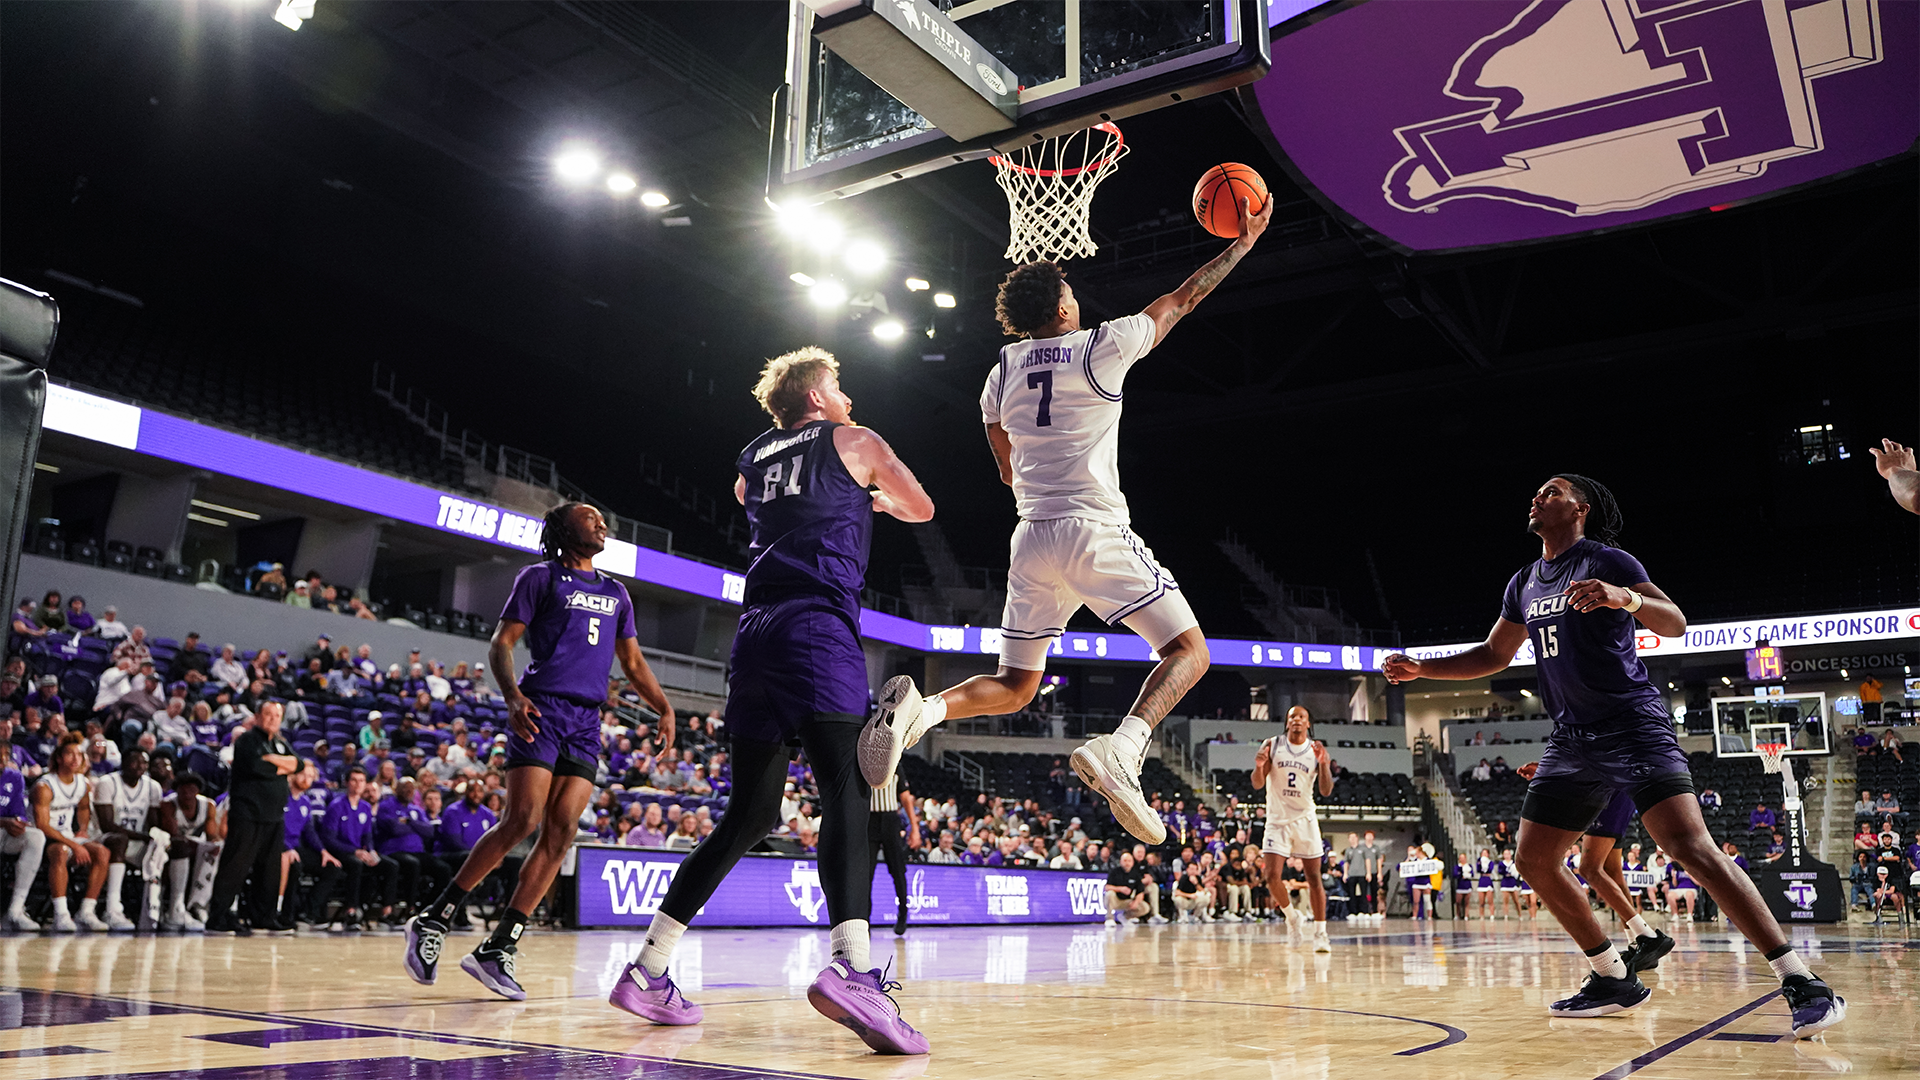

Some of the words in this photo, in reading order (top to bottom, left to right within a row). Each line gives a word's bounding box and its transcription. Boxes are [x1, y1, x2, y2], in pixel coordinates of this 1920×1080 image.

[921, 11, 971, 66] TRIPLE
[934, 37, 957, 60] CROWN
[982, 68, 1002, 91] Ford
[1014, 347, 1072, 369] OHNSON
[1027, 370, 1053, 427] 7
[762, 454, 804, 504] 21
[436, 495, 499, 539] TEXAS
[570, 592, 615, 613] ACU
[1526, 595, 1569, 619] ACU
[587, 617, 600, 646] 5
[1538, 624, 1560, 659] 15
[1683, 626, 1752, 648] TODAY'S
[1757, 622, 1808, 642] GAME
[1813, 615, 1900, 639] SPONSOR
[1759, 656, 1780, 678] 14
[1277, 761, 1310, 774] TARLETON
[1287, 772, 1297, 788] 2
[1282, 789, 1302, 798] STATE
[1789, 811, 1801, 867] TEXANS
[601, 860, 704, 915] WA
[985, 875, 1029, 895] TEXANS
[1631, 873, 1655, 885] LOUD
[1066, 878, 1108, 915] WA
[845, 984, 861, 992] MARK
